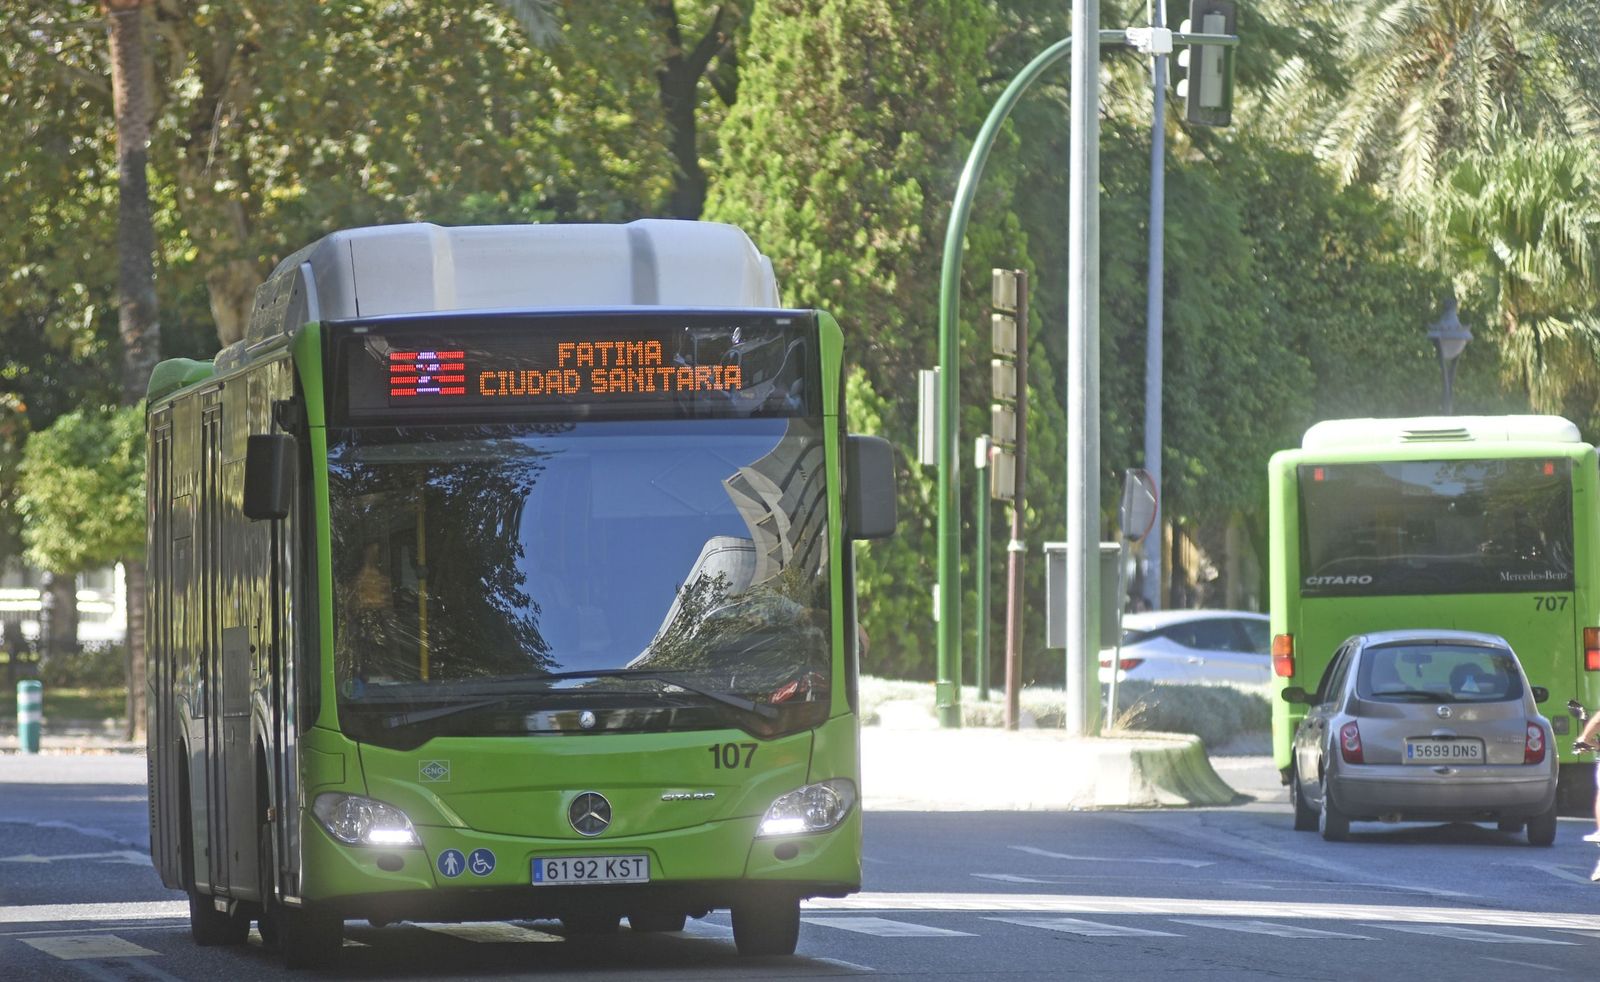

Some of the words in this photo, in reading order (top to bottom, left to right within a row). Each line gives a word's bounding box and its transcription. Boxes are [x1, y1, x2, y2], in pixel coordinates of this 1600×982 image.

[558, 340, 662, 367] FATIMA
[479, 369, 581, 396] CIUDAD
[591, 365, 742, 393] SANITARIA
[1306, 575, 1373, 585] CITARO
[1500, 570, 1568, 581] Mercedes-Benz
[1533, 596, 1568, 611] 707
[708, 742, 758, 769] 107
[1416, 744, 1449, 757] 5699
[1453, 744, 1477, 757] DNS
[425, 767, 444, 775] CNG
[547, 860, 598, 879] 6192
[606, 858, 643, 878] KST
